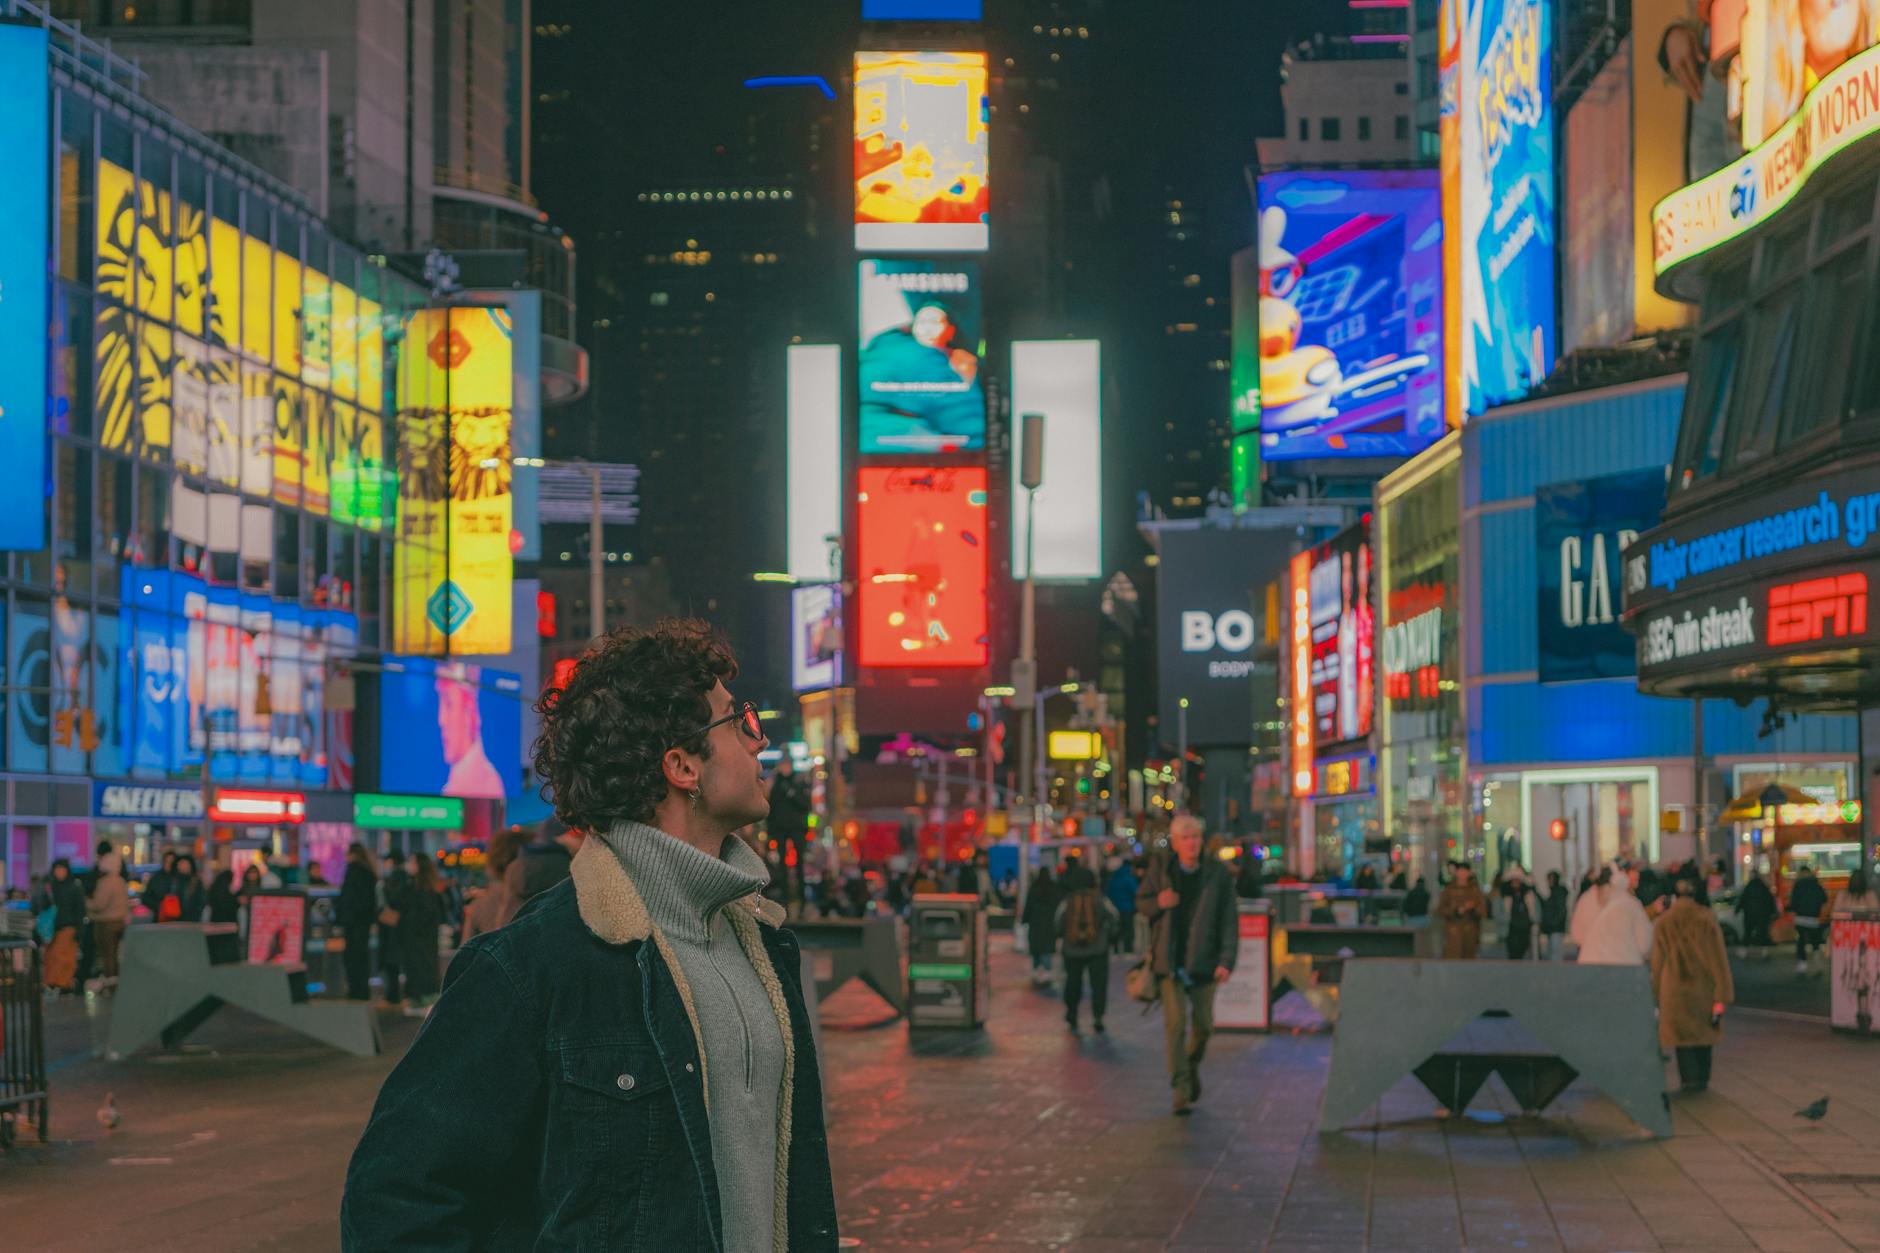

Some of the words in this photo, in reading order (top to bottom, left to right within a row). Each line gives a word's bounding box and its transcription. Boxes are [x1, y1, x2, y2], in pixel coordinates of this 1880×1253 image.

[1818, 64, 1880, 143] MORN
[881, 273, 969, 293] MSUNG
[1561, 529, 1639, 628] GA
[1650, 538, 1689, 592] Major
[1689, 526, 1744, 576] cancer
[1744, 490, 1840, 560] research
[1649, 615, 1674, 664] SEC
[1673, 610, 1699, 658] win
[1701, 596, 1755, 652] streak
[1767, 572, 1868, 647] ESPN
[101, 785, 203, 818] SKECHERS
